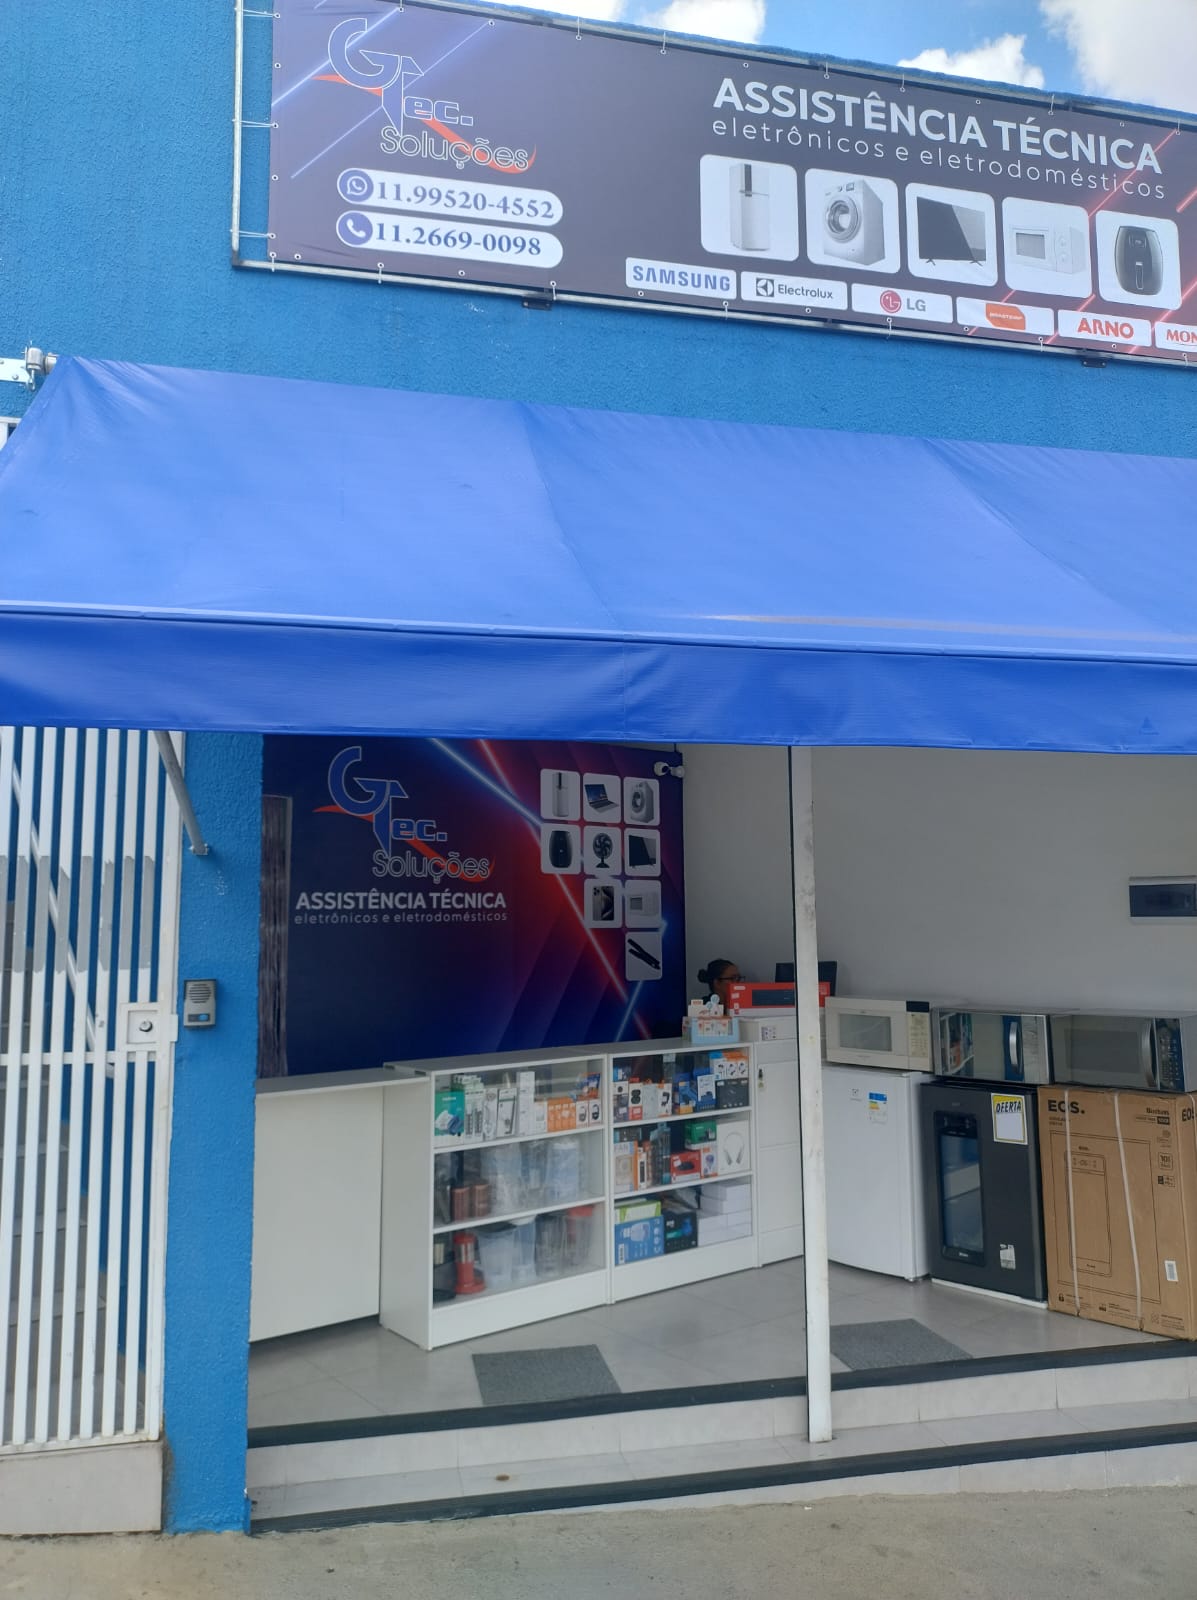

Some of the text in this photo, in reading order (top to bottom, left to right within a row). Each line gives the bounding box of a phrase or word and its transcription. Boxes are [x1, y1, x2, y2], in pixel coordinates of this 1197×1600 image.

[712, 78, 1163, 175] ASSISTÊNCIA TÉCNICA
[380, 126, 529, 169] Soluções
[712, 117, 1165, 200] eletrônicos e eletrodomésticos
[376, 181, 555, 220] 11.99520-4552
[376, 222, 542, 256] 11.2669-0098
[632, 265, 731, 292] SAMSUNG
[777, 284, 834, 300] Electrolux
[906, 298, 926, 312] LG
[1077, 318, 1135, 339] ARNO
[372, 850, 490, 884] Soluções
[295, 888, 507, 910] ASSISTÊNCIA TÉCNICA
[294, 910, 508, 925] eletrônicos e eletrodomésticos
[995, 1101, 1022, 1113] OFERTA
